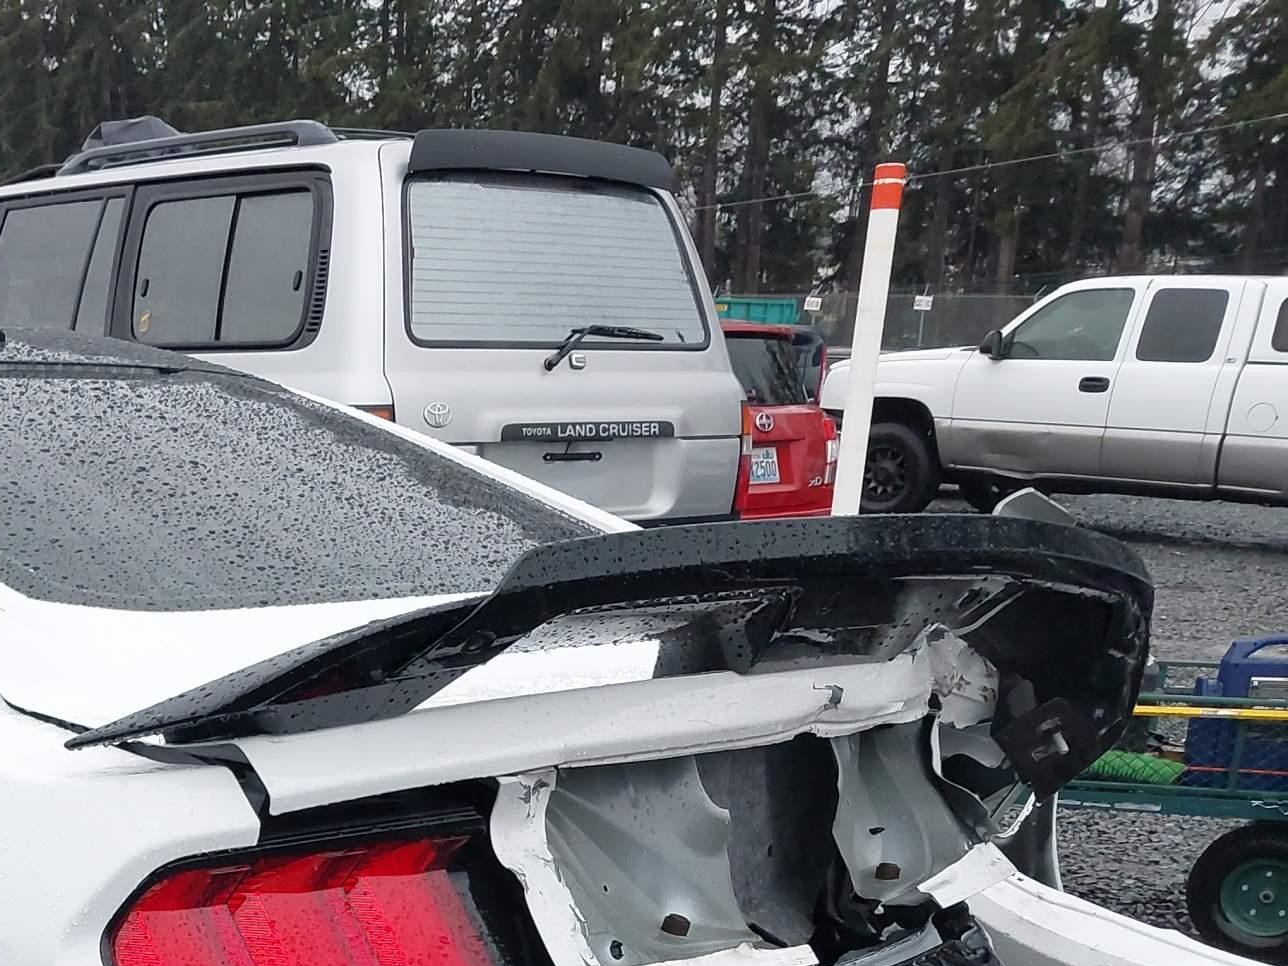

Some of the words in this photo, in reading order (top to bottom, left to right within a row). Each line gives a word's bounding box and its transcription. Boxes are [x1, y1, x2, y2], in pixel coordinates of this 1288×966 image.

[521, 427, 552, 437] TOYOTA
[557, 424, 596, 438] LAND
[599, 422, 660, 437] CRUISER
